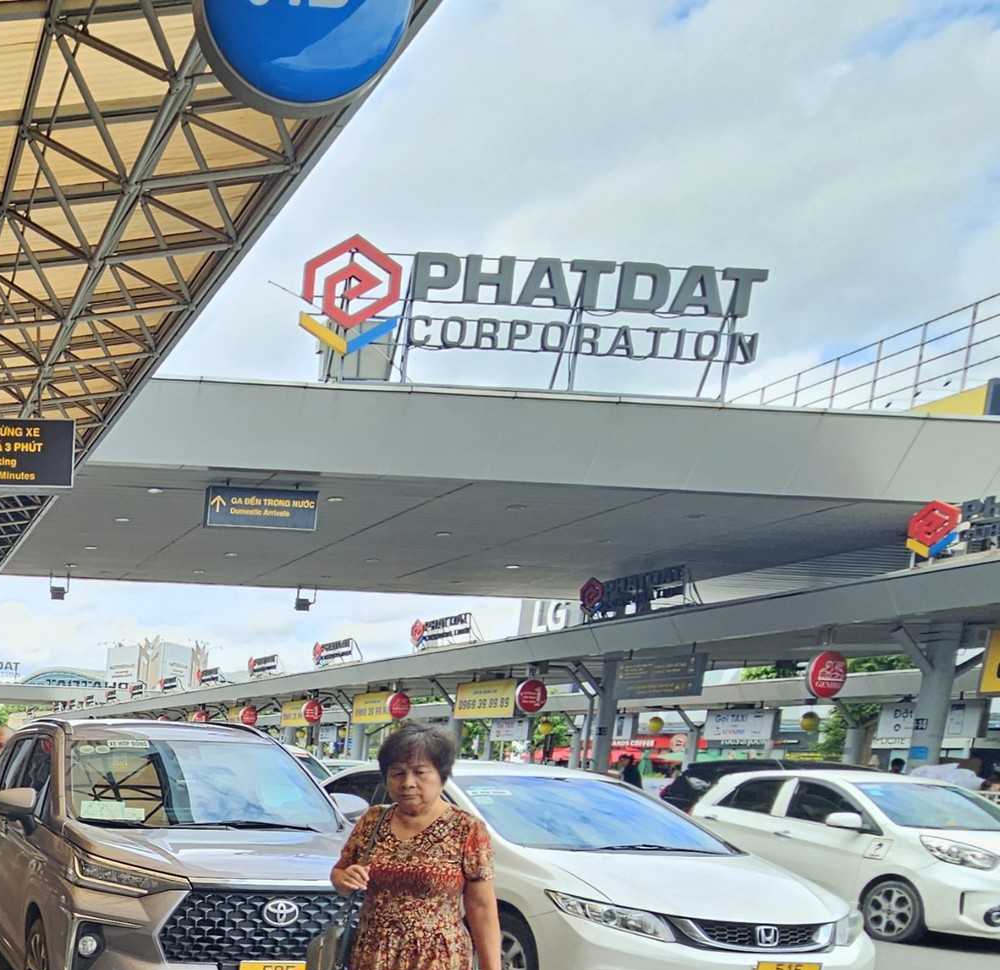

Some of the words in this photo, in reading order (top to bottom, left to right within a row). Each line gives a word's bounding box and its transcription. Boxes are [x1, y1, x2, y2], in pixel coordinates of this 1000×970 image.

[412, 252, 769, 318] PHATDAT
[409, 315, 760, 365] CORPORATION
[26, 427, 40, 437] XE
[5, 442, 11, 452] 3
[14, 440, 43, 452] PHÚT
[231, 497, 243, 505] GA
[263, 498, 291, 507] TRONG
[731, 714, 747, 722] TAXI
